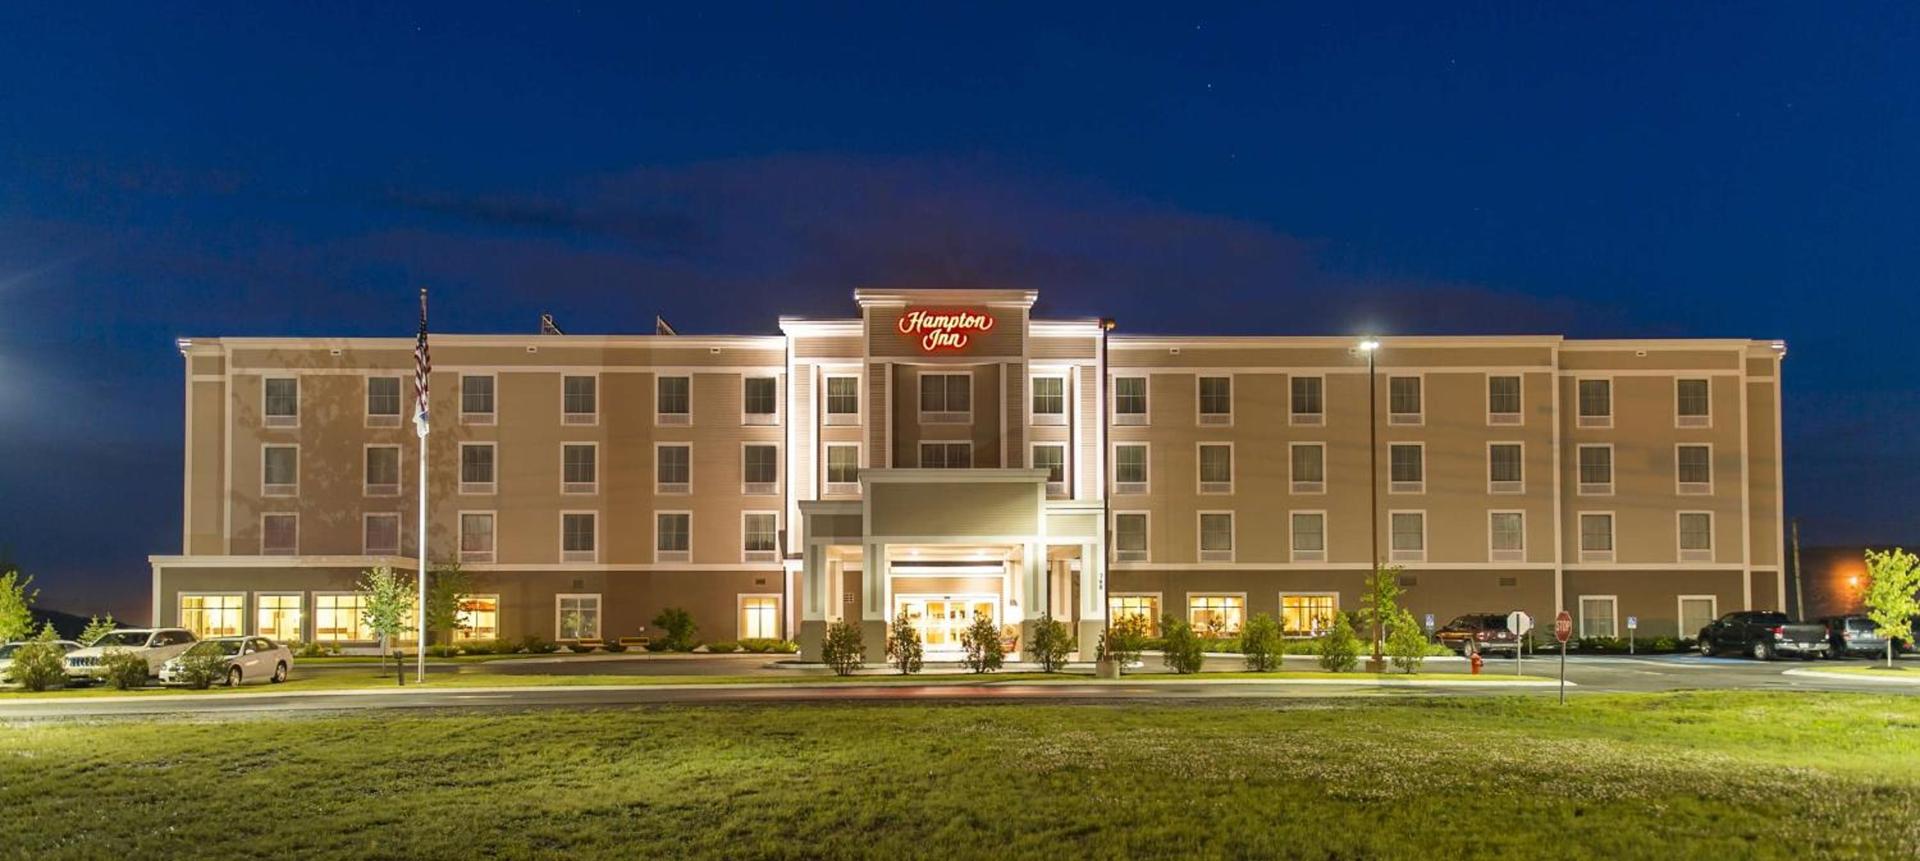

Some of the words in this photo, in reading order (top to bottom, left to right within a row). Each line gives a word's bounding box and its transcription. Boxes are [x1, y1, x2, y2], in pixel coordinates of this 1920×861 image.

[899, 310, 993, 333] Hampton
[922, 328, 967, 350] Inn
[1556, 620, 1570, 632] STOP
